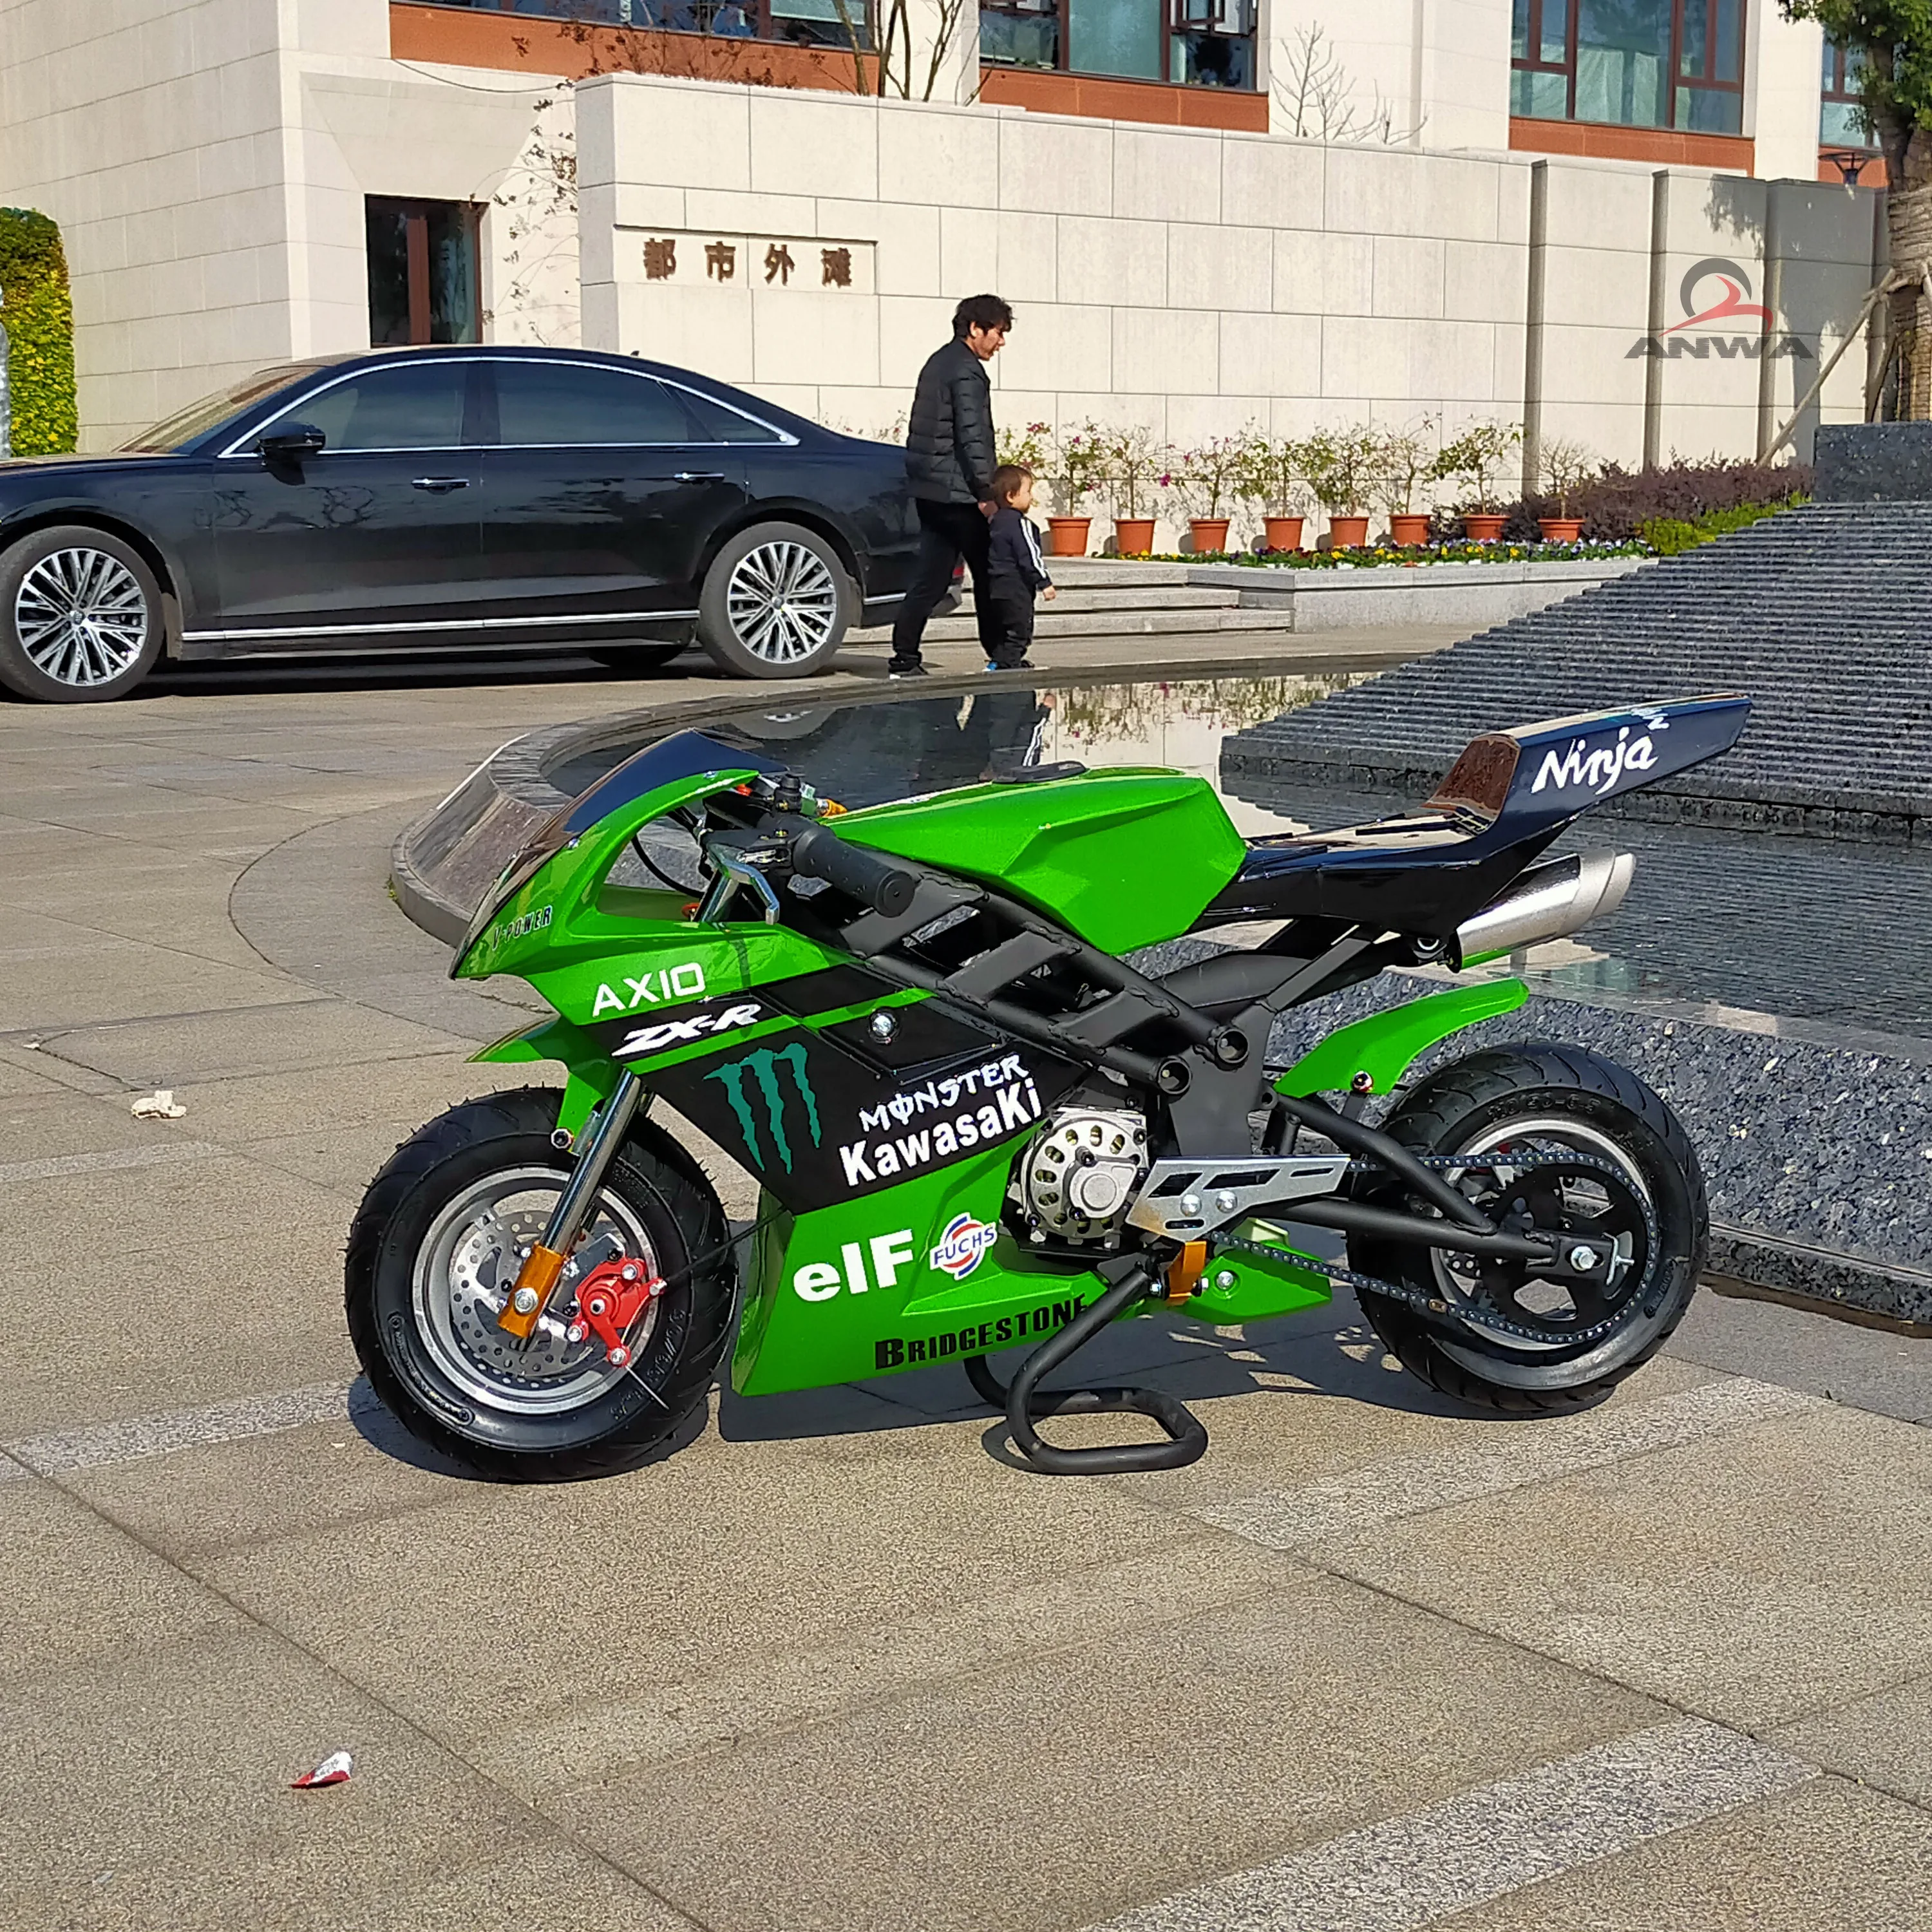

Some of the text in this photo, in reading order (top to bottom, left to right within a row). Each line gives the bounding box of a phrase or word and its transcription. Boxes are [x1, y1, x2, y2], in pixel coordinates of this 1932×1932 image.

[1531, 727, 1658, 796] Ninja
[492, 905, 553, 951] V-POWER
[592, 962, 706, 1018] AXIO
[612, 1004, 761, 1056] ZX-R
[934, 1226, 995, 1265] FUCHS
